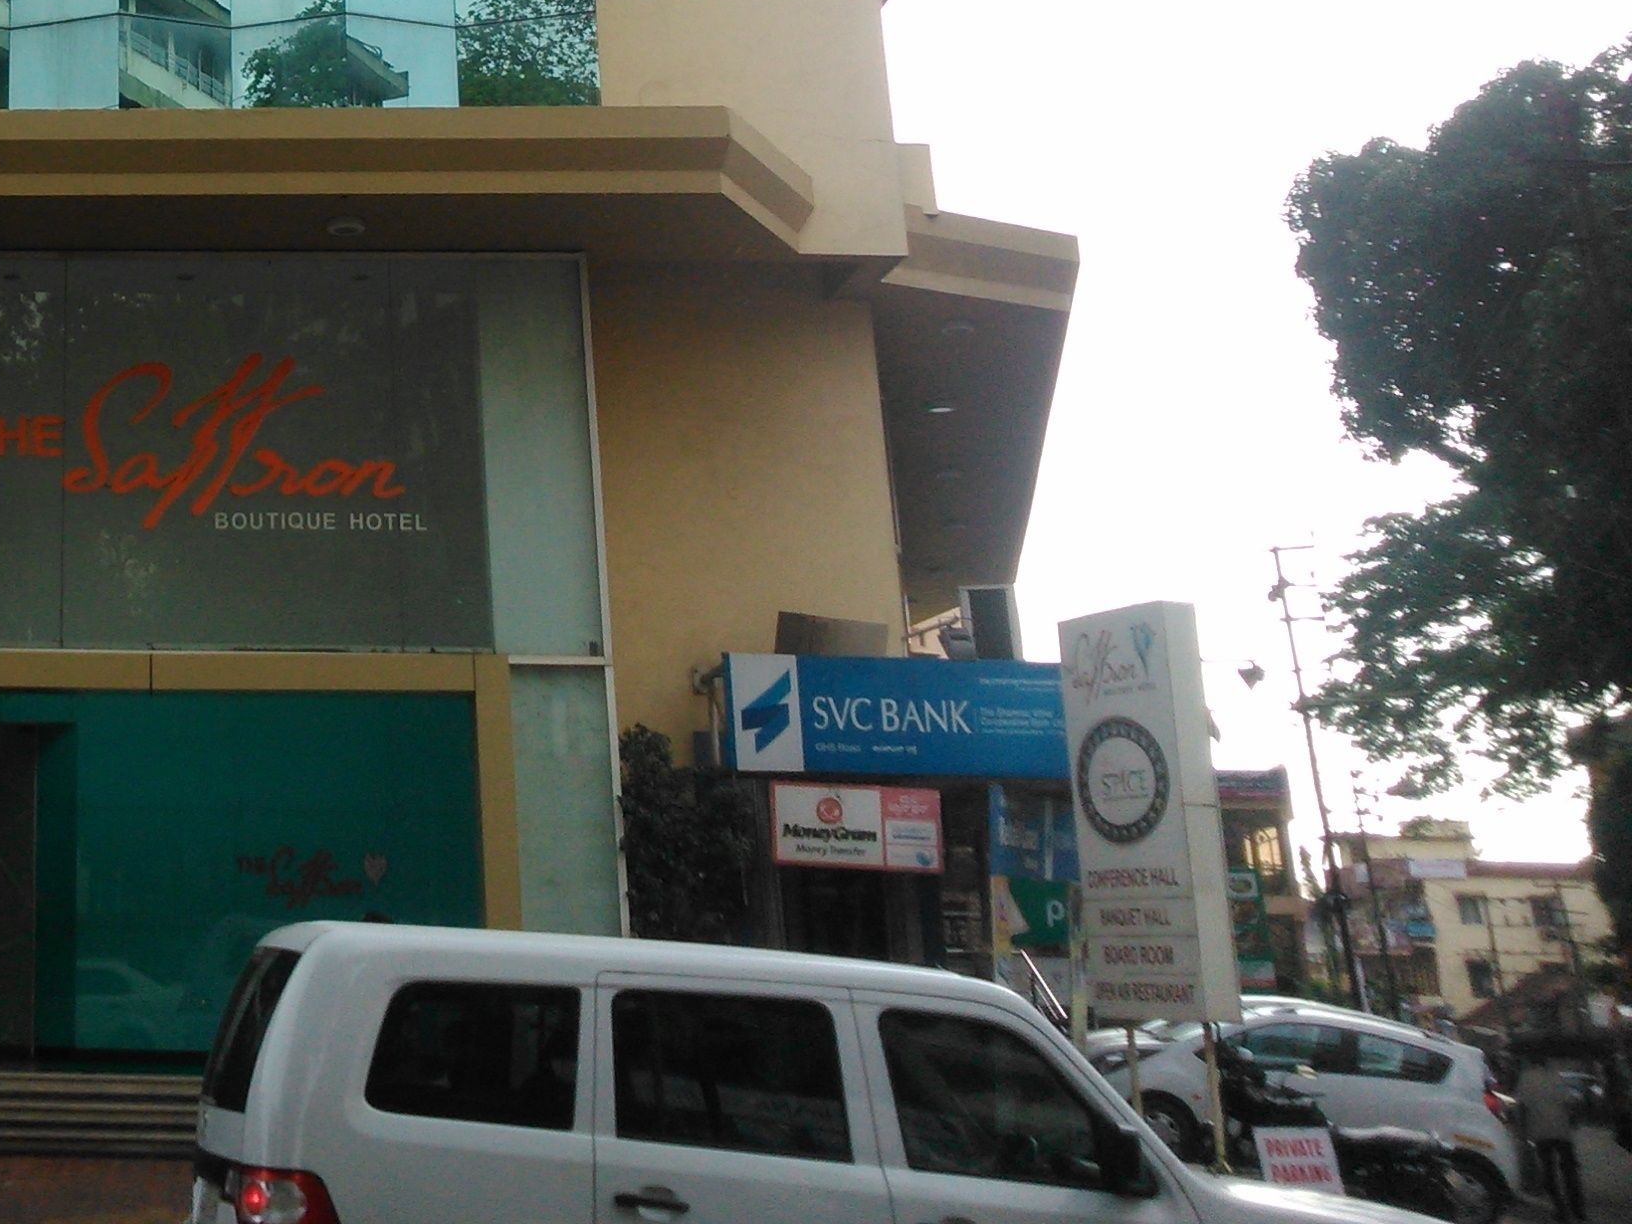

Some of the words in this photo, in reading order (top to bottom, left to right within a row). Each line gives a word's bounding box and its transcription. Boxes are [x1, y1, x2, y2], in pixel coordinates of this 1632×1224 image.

[61, 353, 406, 531] Saffron
[214, 511, 337, 531] BOUTIQUE
[349, 512, 427, 531] HOTEL
[812, 694, 873, 733] SVC
[880, 696, 972, 735] BANK
[782, 822, 878, 843] MoneyGram
[1149, 866, 1179, 887] HALL
[1143, 908, 1172, 927] HALL
[1104, 945, 1138, 965] BOARD
[1140, 945, 1174, 965] ROOM
[1264, 1137, 1323, 1158] PRIVATE
